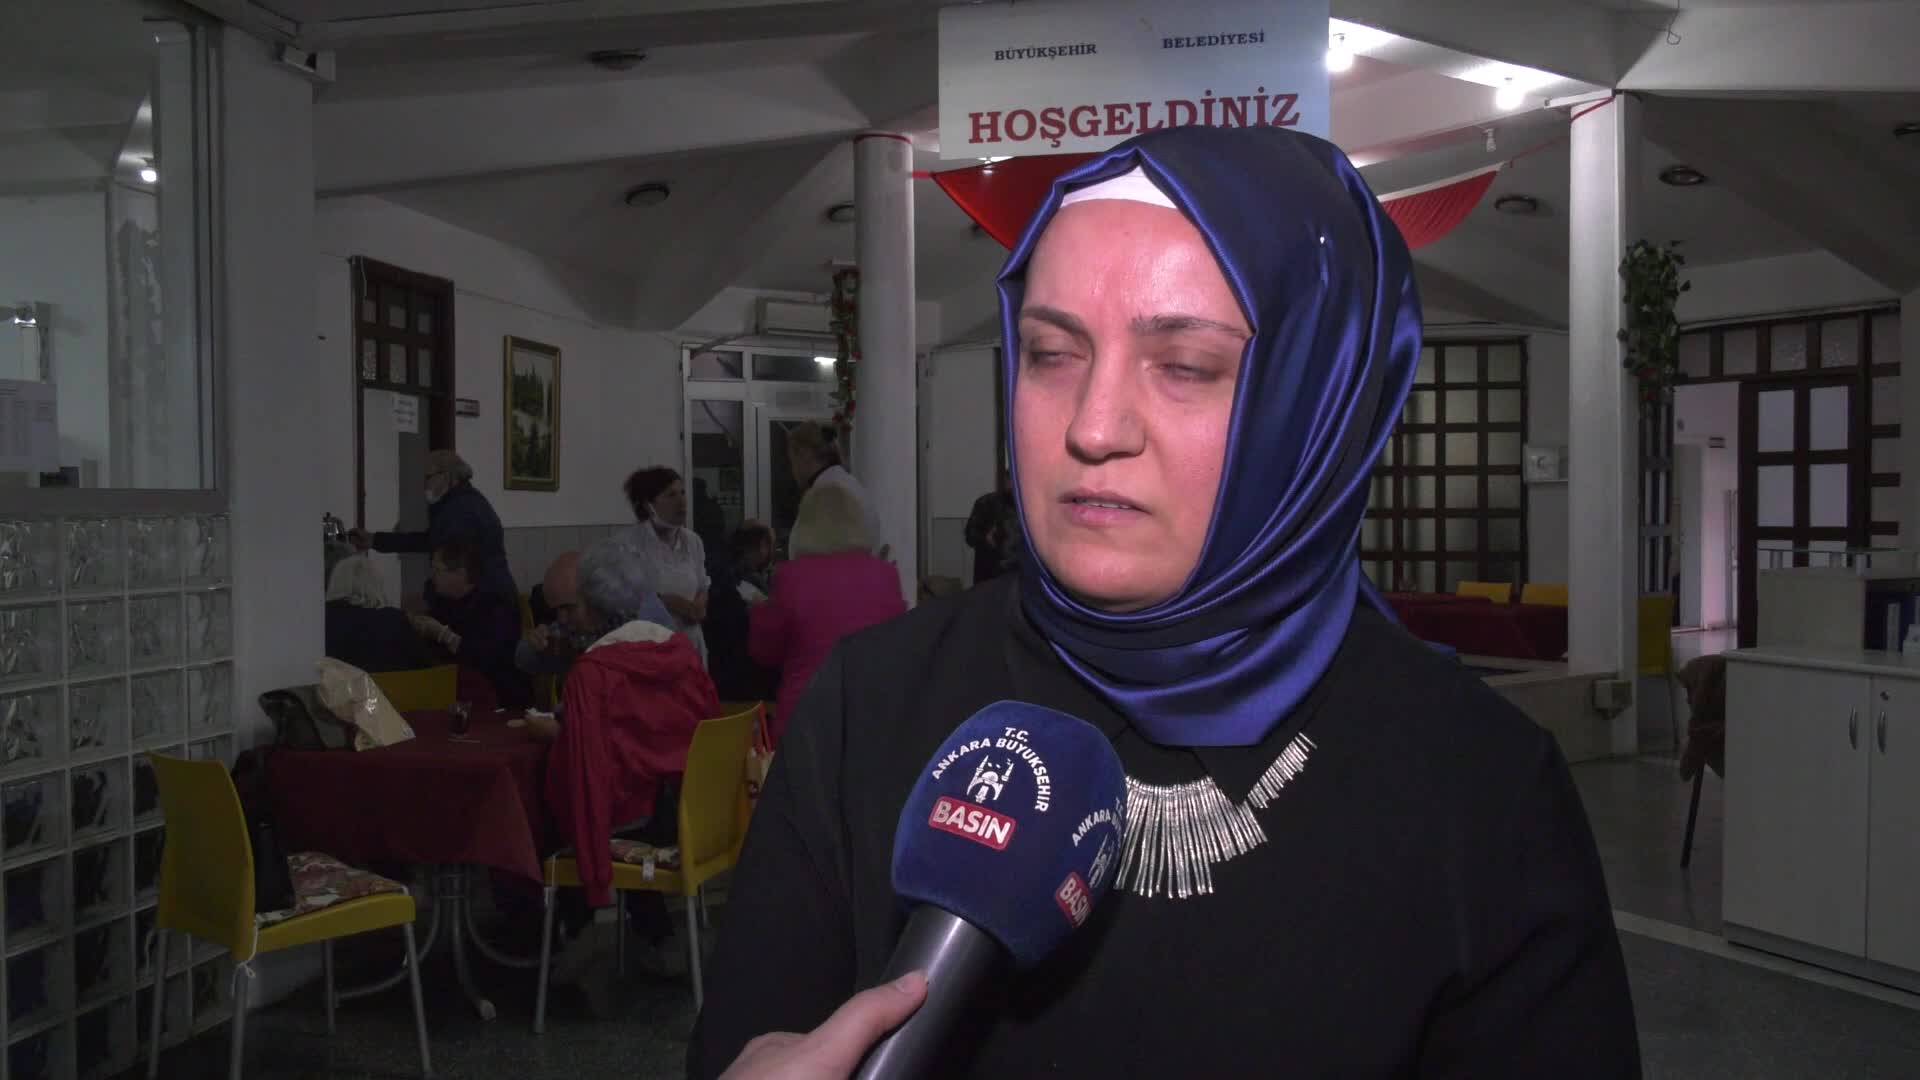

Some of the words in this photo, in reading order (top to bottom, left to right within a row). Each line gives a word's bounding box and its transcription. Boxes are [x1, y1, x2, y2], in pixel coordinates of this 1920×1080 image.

[994, 43, 1097, 62] BÜYÜKŞEHİR
[1162, 29, 1265, 49] BELEDİYESİ
[968, 87, 1300, 147] HOŞGELDİNİZ
[1005, 727, 1029, 742] T.C.
[932, 738, 991, 780] ANKARA
[933, 801, 1011, 844] BASIN
[1072, 809, 1112, 847] ANKARA
